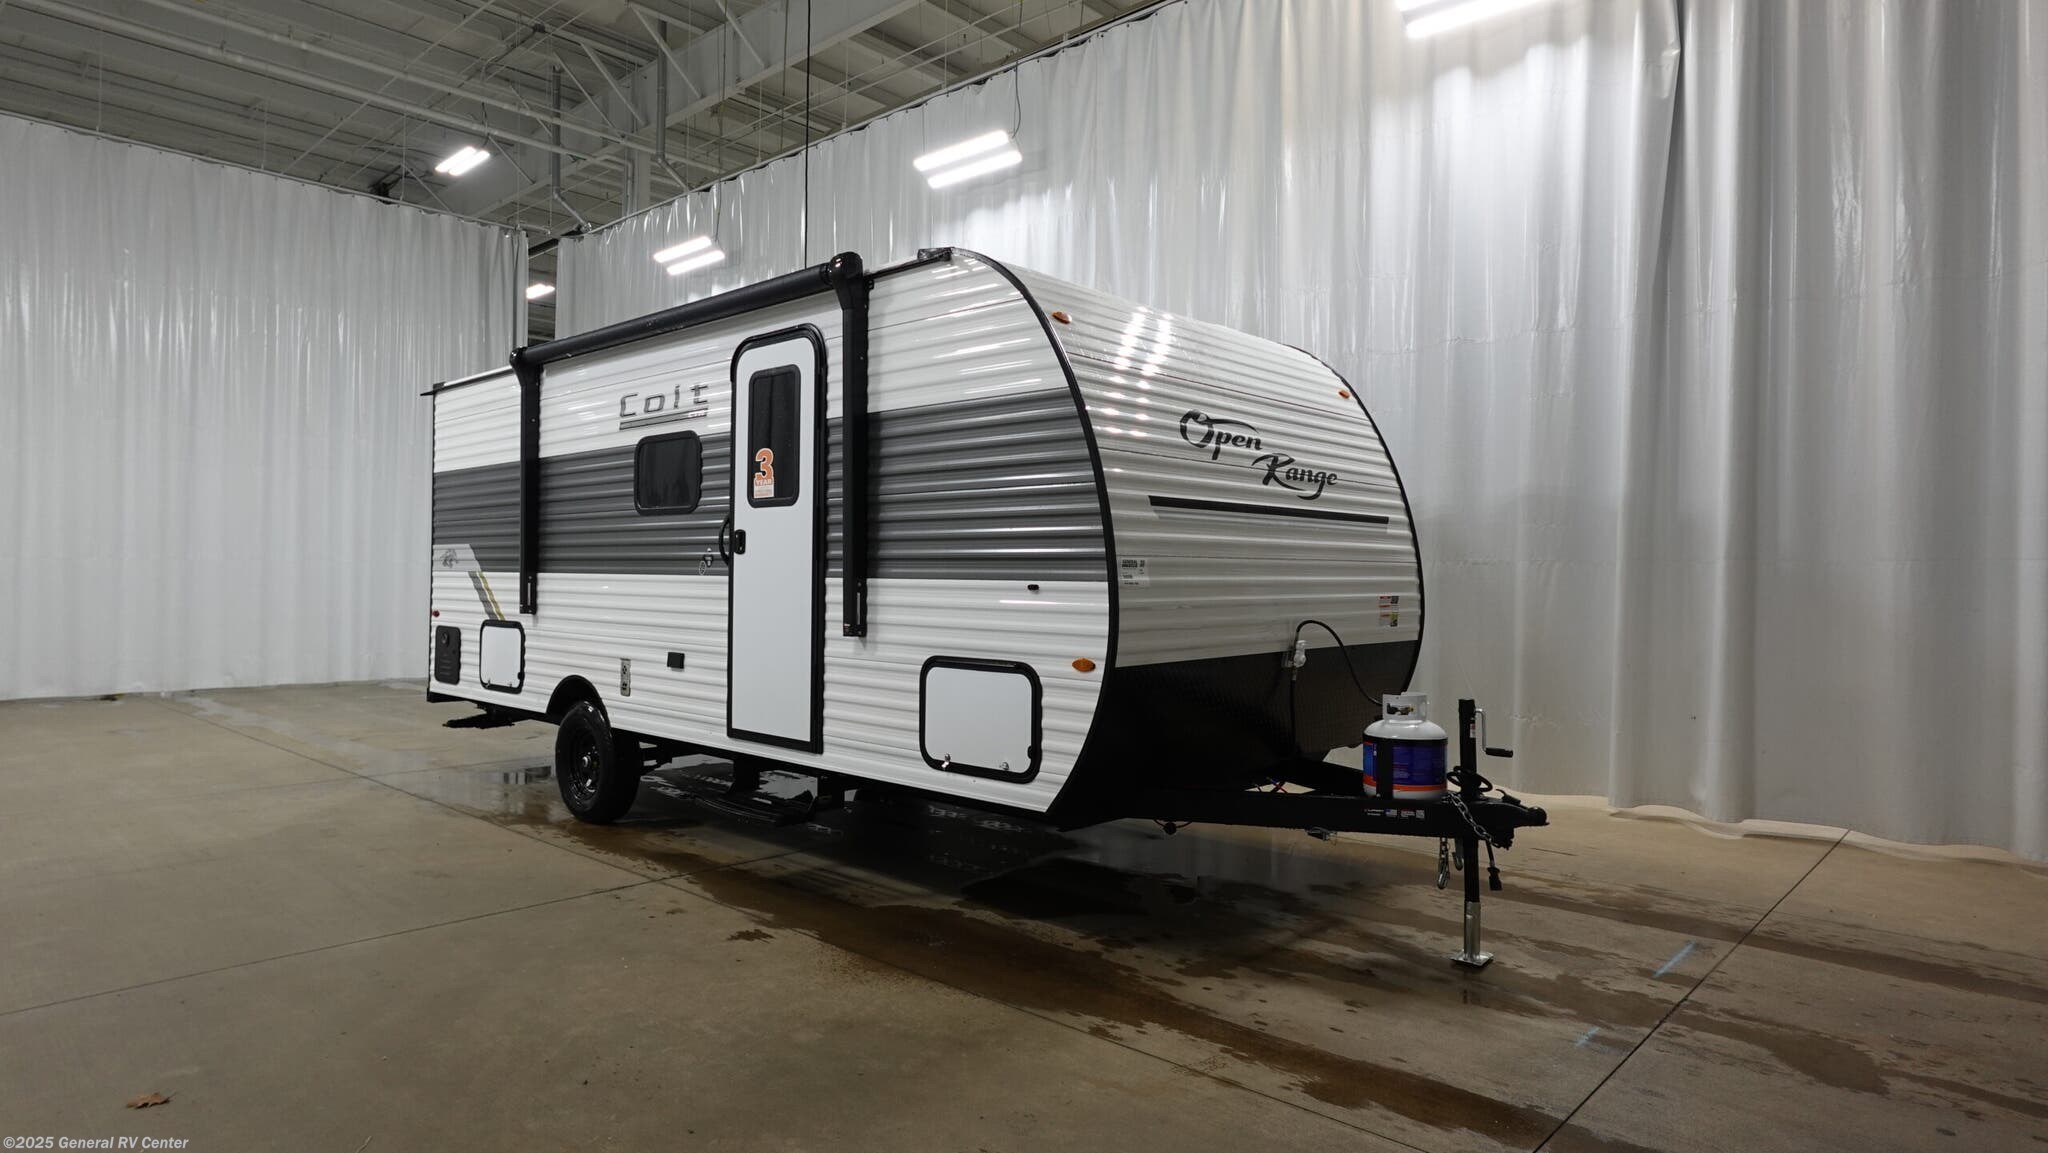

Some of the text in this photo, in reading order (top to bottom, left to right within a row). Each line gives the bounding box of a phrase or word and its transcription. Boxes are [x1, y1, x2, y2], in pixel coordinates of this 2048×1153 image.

[619, 384, 709, 418] Colt
[1179, 409, 1263, 461] Open
[755, 448, 774, 480] 3
[1251, 453, 1338, 501] Range
